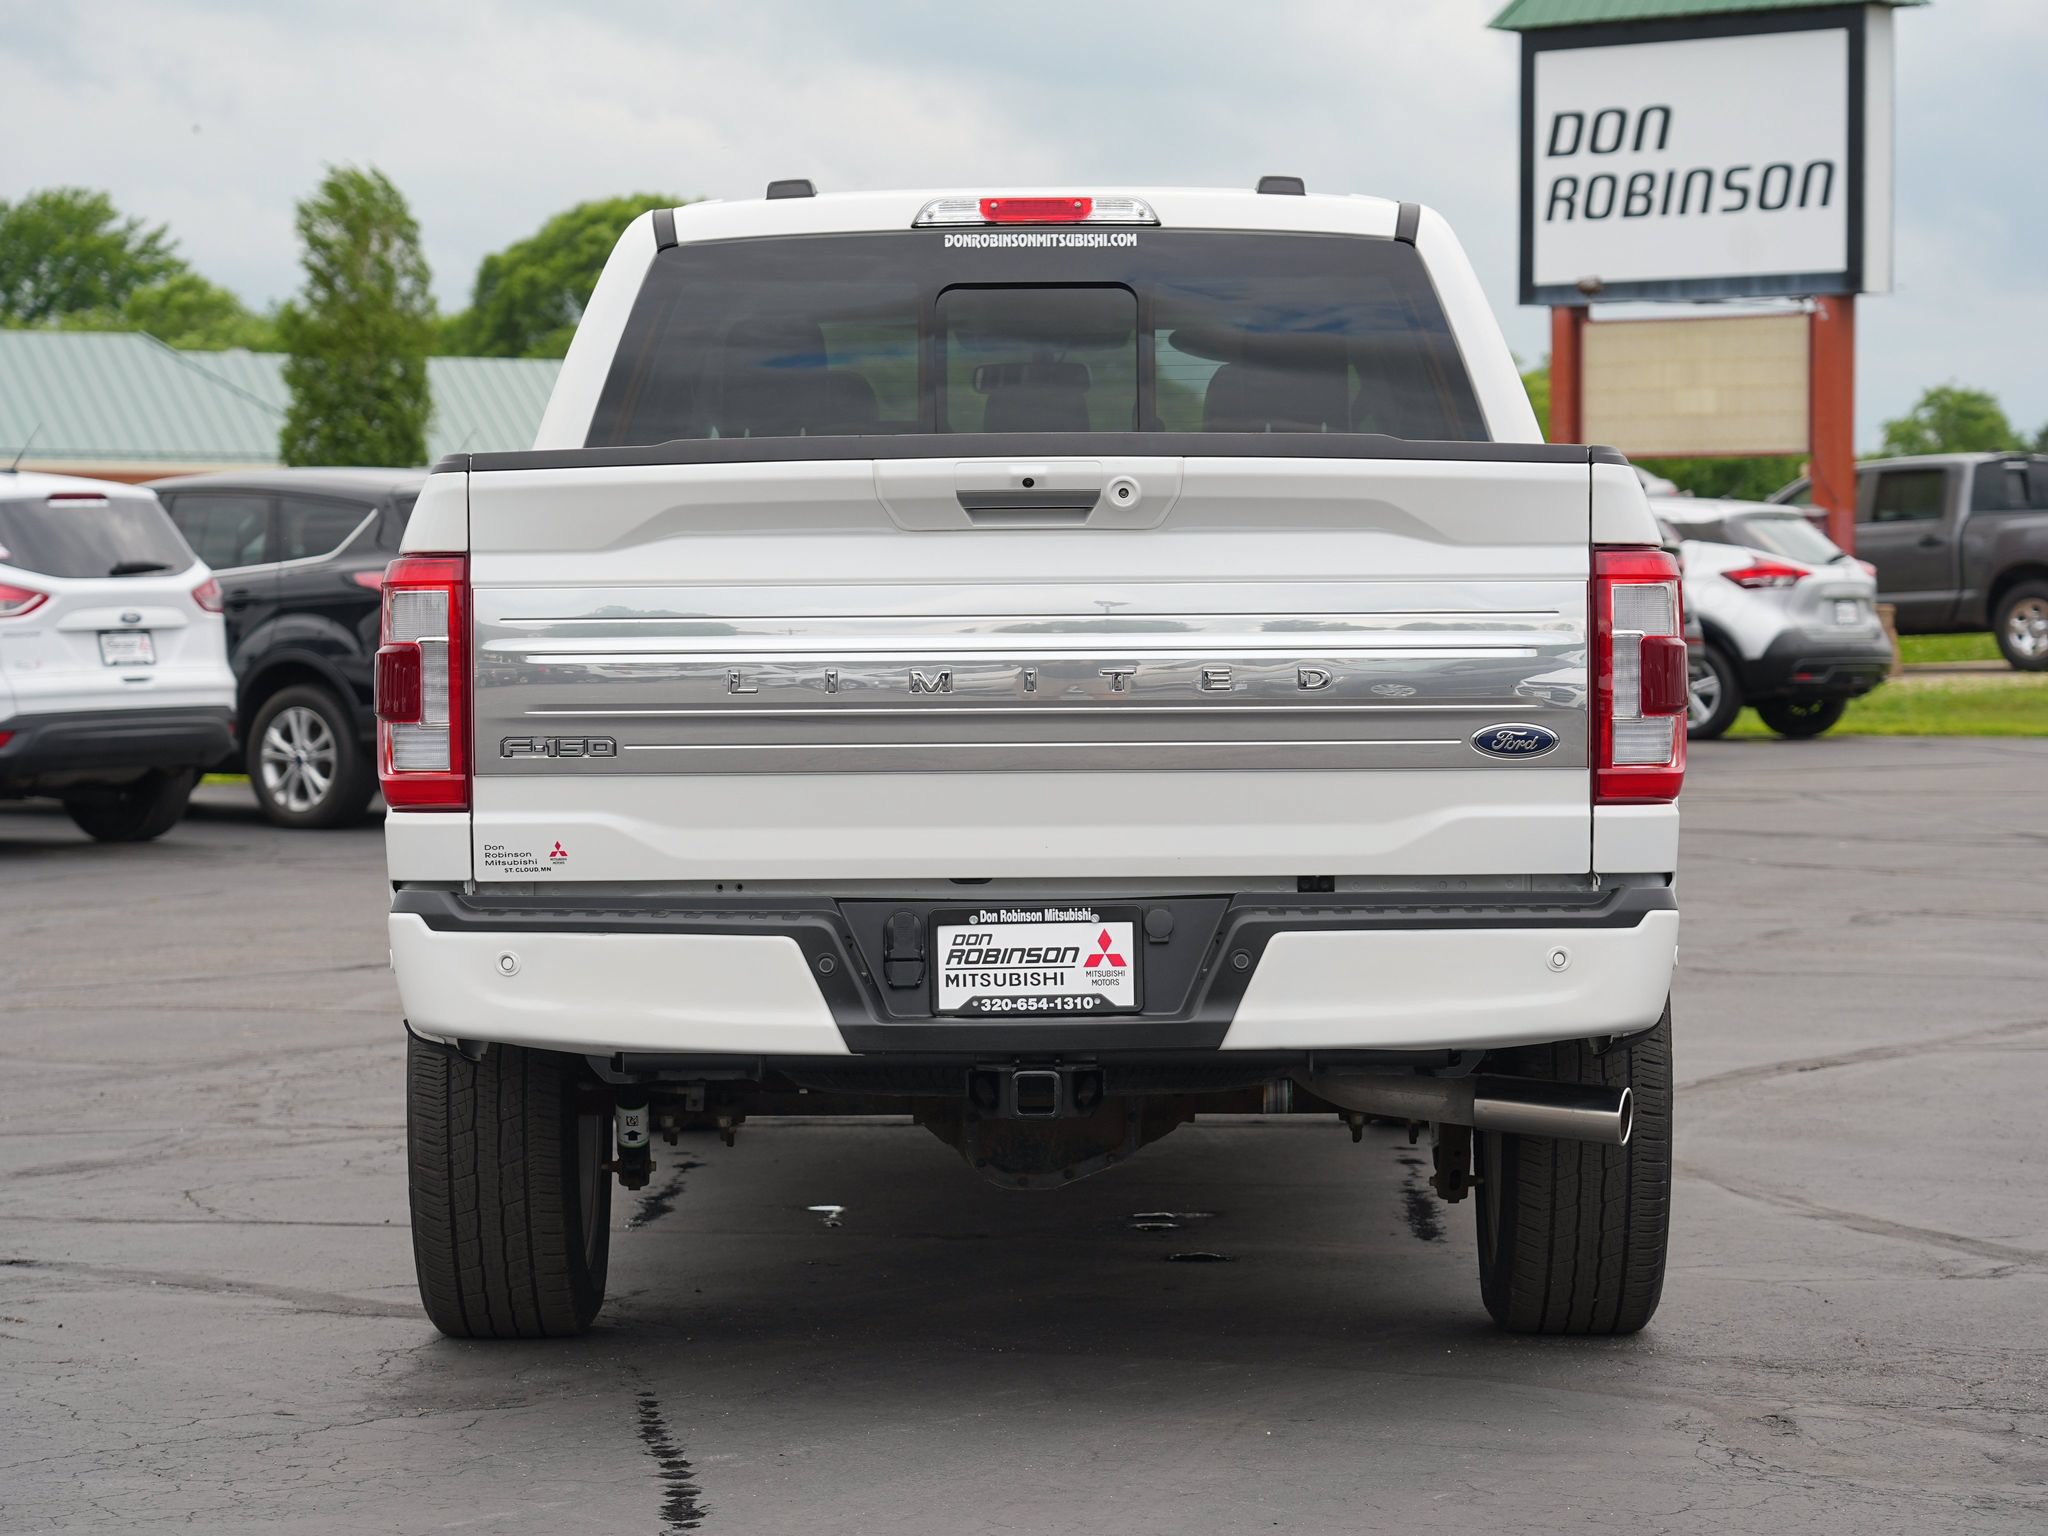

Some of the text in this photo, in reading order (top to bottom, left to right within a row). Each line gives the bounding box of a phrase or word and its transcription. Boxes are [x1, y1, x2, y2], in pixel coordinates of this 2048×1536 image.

[1547, 104, 1672, 157] DON
[1546, 160, 1835, 221] ROBINSON
[944, 233, 1137, 248] DONROBINSONMITSUBISHI.COM
[727, 666, 1334, 696] LIMITED
[500, 736, 617, 758] F-150
[1491, 730, 1539, 750] Ford
[484, 851, 532, 859] Robinson
[485, 858, 538, 867] Mitsubishi
[979, 907, 1092, 923] Don Robinson Mitsubishi
[952, 933, 993, 946] DON
[945, 946, 1080, 965] ROBINSON
[945, 972, 1065, 987] MITSUBISHI
[1085, 970, 1126, 978] MITSUBISHI
[1091, 978, 1120, 987] MOTORS
[980, 997, 1094, 1012] 320-654-1310
